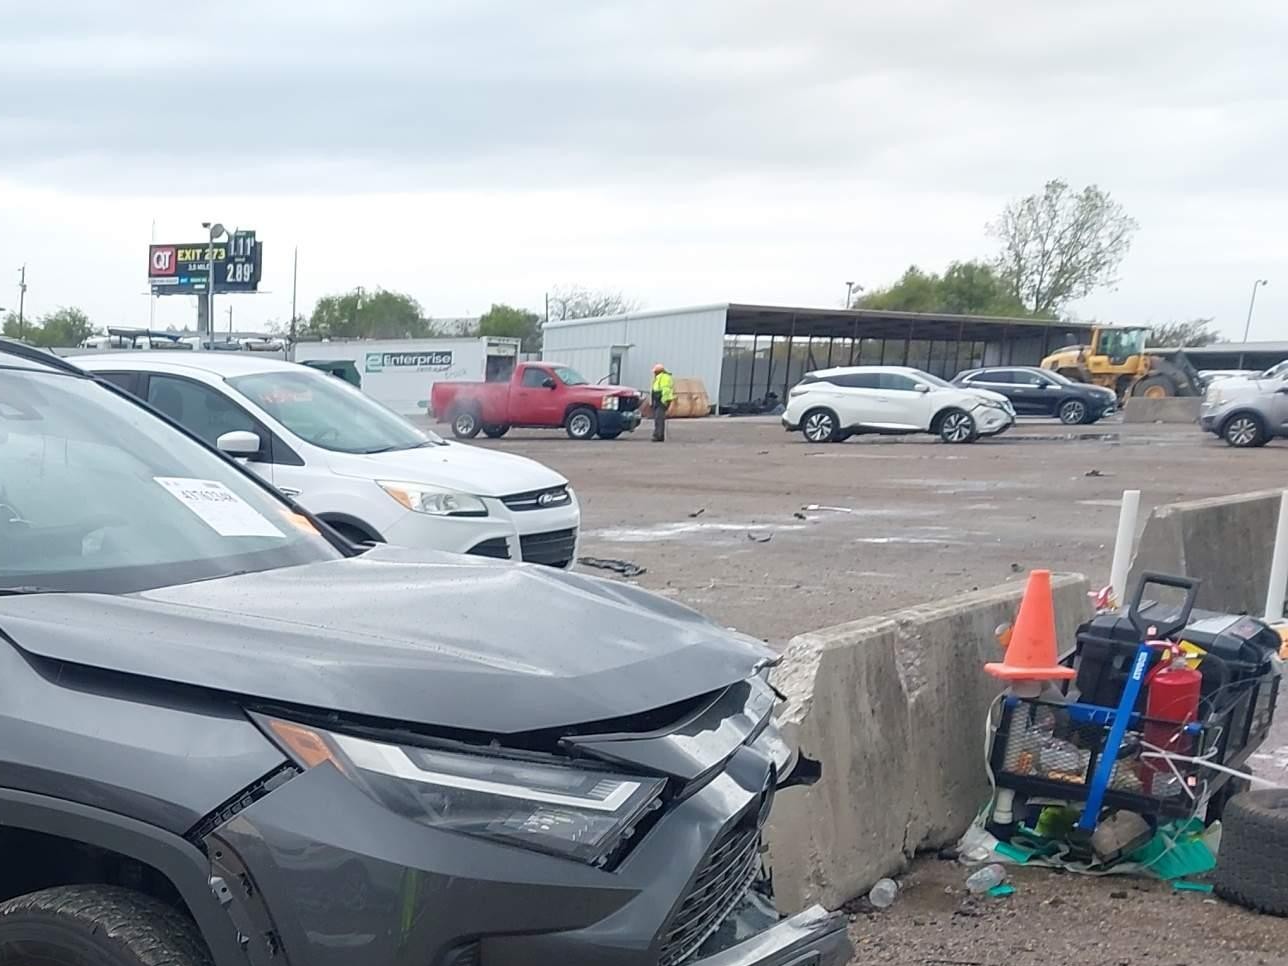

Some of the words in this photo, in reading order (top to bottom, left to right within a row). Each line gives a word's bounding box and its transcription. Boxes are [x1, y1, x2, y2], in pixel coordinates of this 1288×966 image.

[153, 251, 172, 270] QT
[177, 249, 202, 261] EXIT
[204, 248, 226, 261] 273
